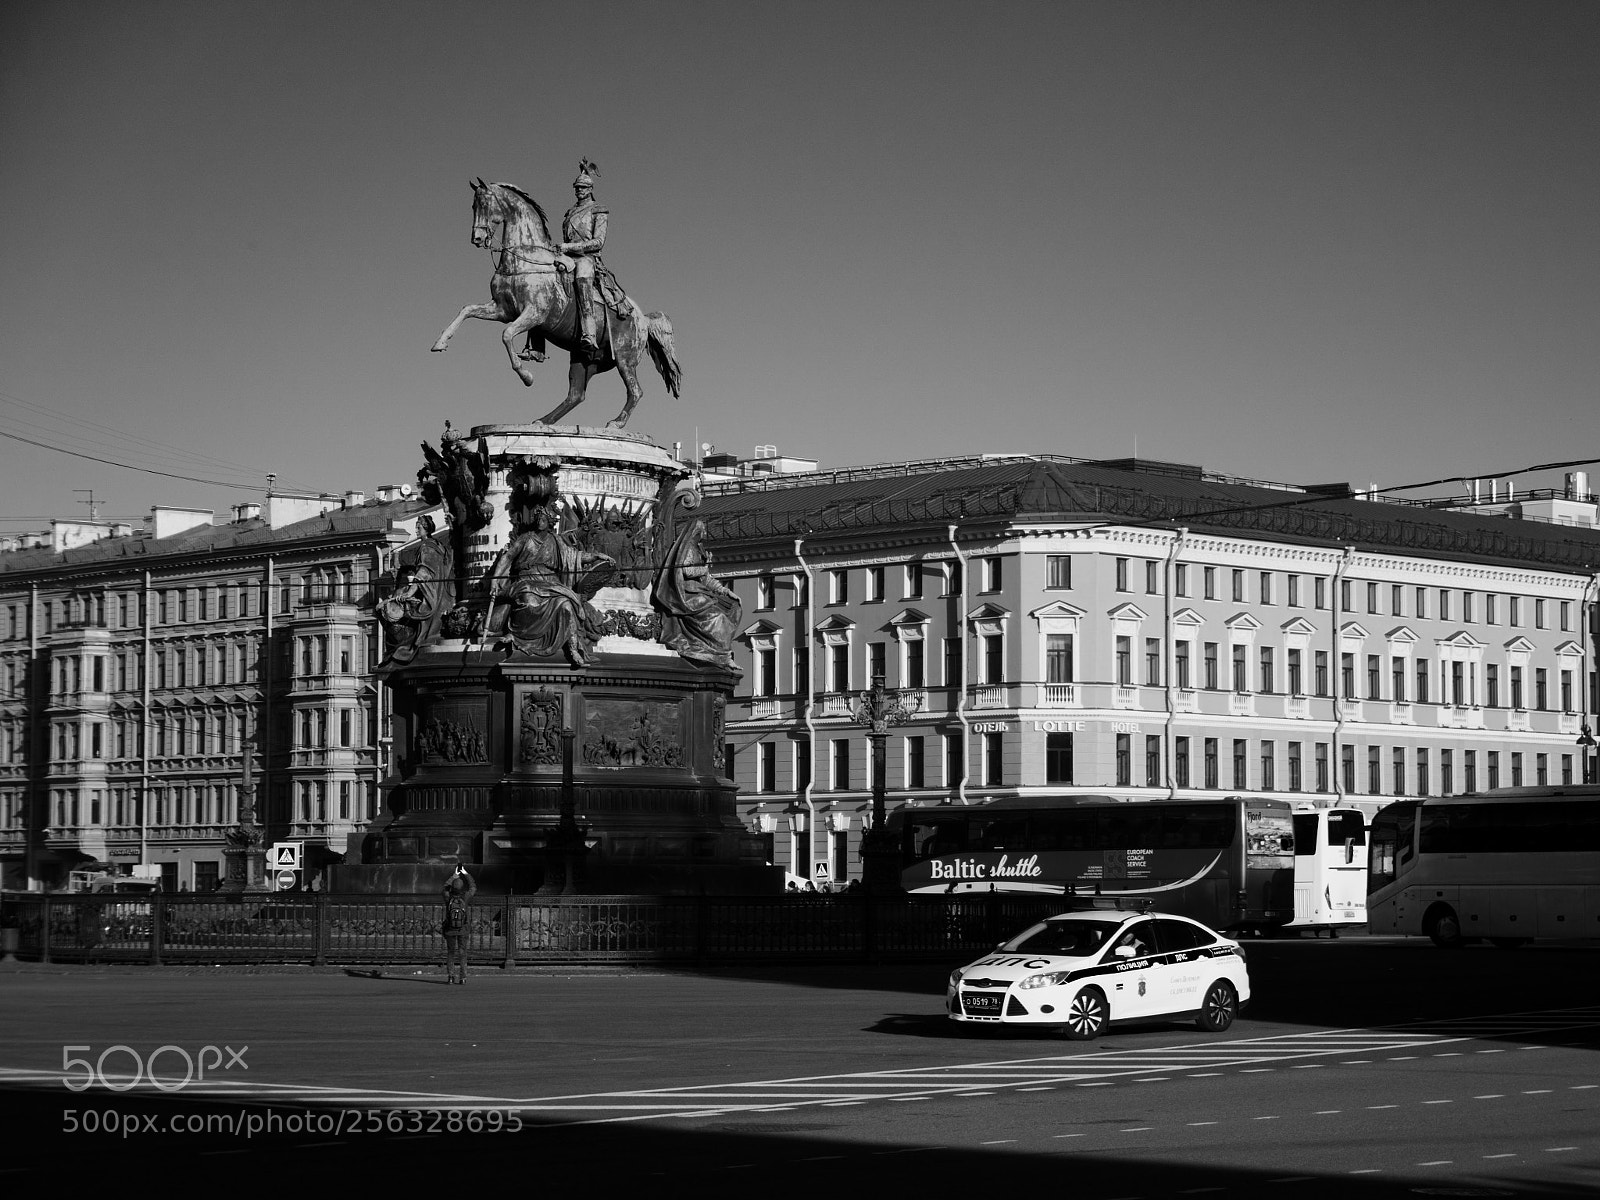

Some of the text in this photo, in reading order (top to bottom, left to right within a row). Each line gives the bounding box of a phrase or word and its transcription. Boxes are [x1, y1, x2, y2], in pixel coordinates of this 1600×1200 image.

[974, 721, 1008, 733] ОТЕЛЬ
[1034, 720, 1086, 732] LOTTE
[1111, 721, 1142, 734] HOTEL
[930, 854, 1043, 879] Baltic shuttle
[1174, 953, 1189, 962] ДПС
[1116, 960, 1149, 972] ПОЛИЦИЯ
